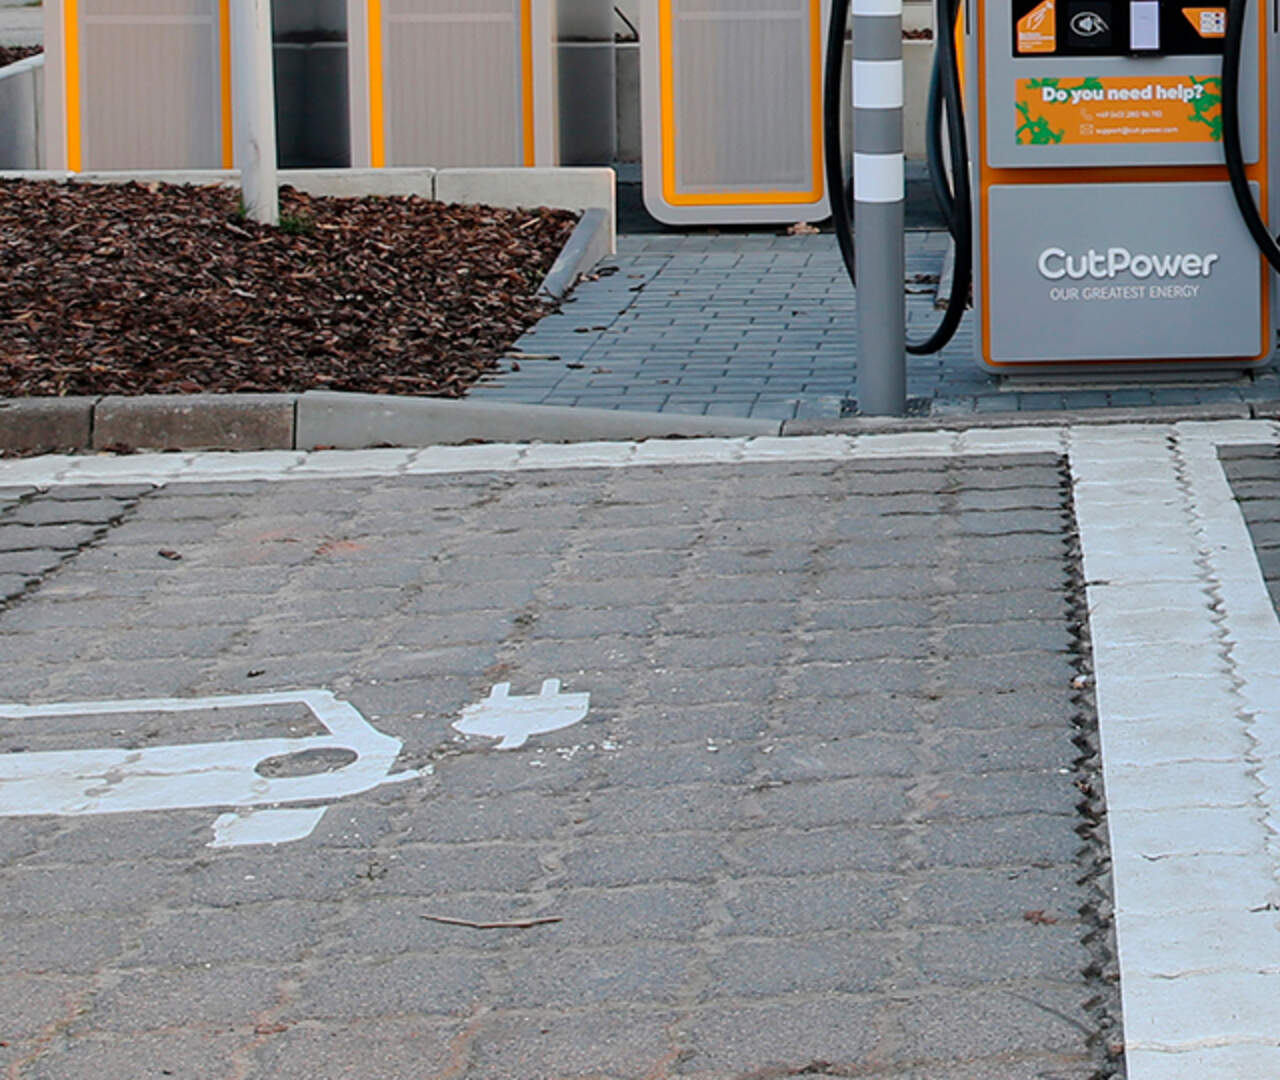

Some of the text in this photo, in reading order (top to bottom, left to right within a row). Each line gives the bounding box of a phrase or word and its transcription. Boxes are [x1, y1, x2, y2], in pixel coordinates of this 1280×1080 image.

[1042, 84, 1205, 104] Do you need help?
[1038, 247, 1218, 279] CutPower
[1050, 285, 1200, 301] OUR GREATEST ENERGY
